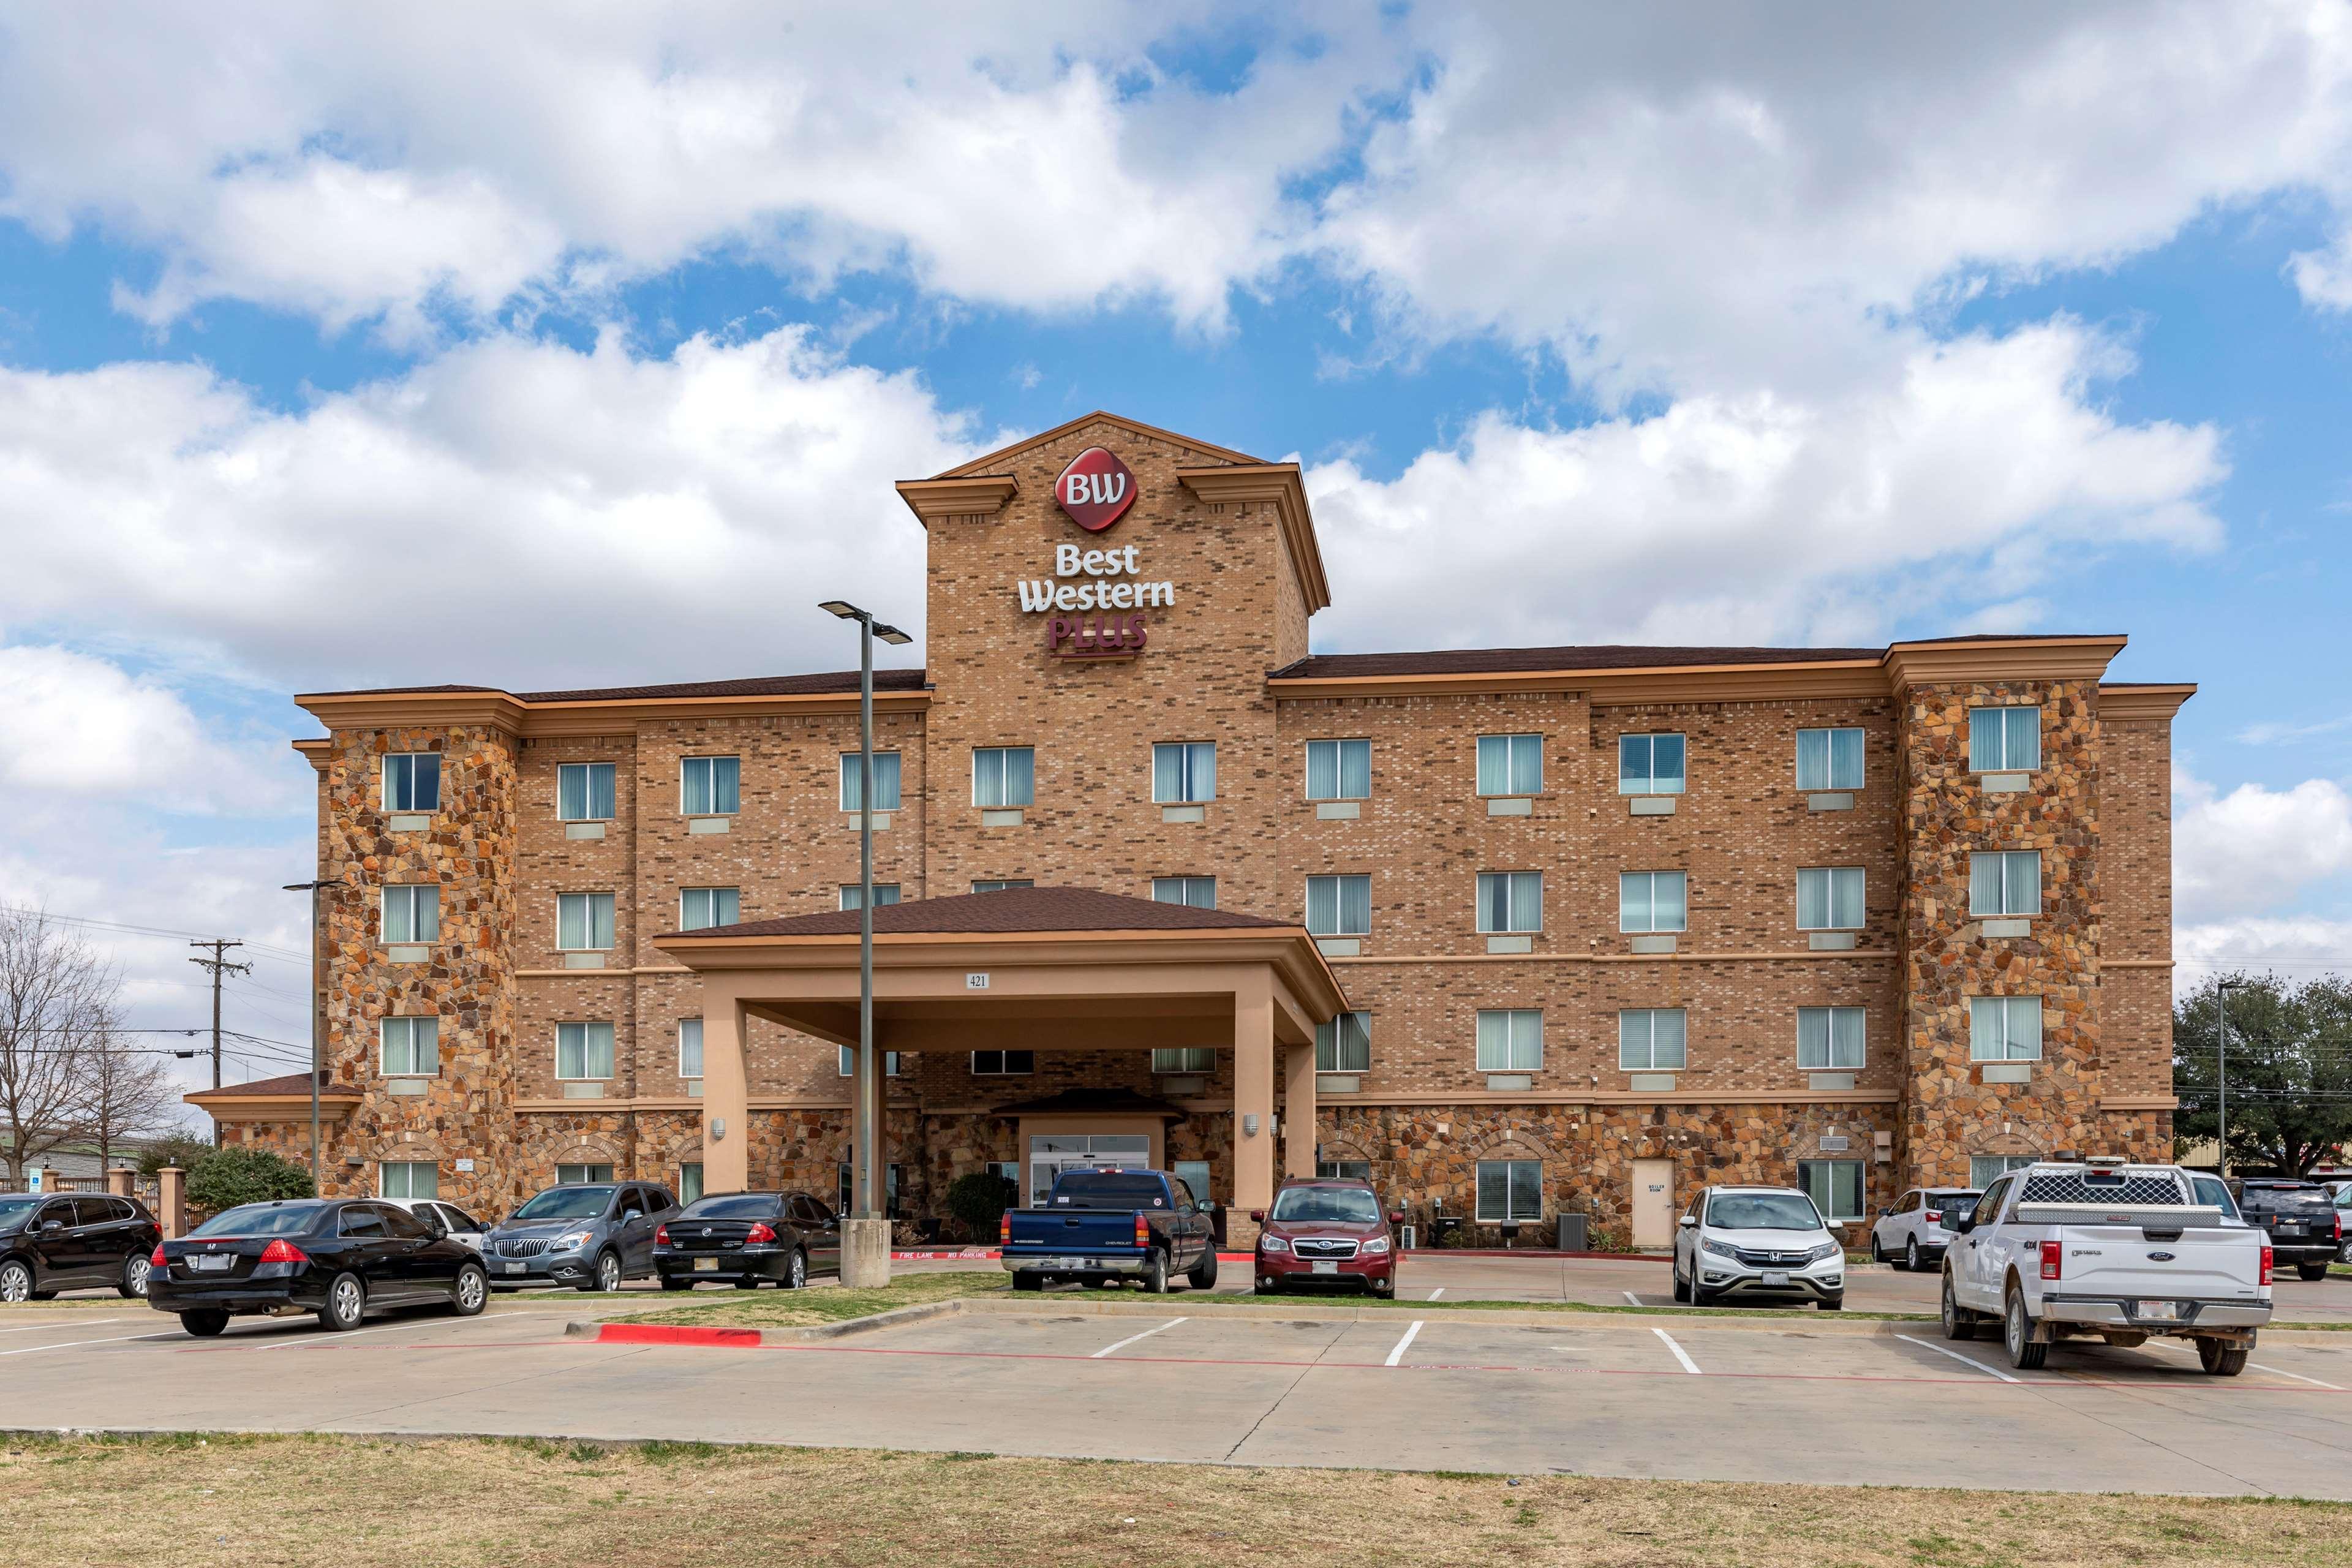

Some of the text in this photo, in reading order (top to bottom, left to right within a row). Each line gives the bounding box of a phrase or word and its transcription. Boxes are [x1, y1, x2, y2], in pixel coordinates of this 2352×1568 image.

[1066, 472, 1126, 505] BW
[1056, 544, 1140, 577] Best
[1017, 579, 1176, 613] Western
[1048, 614, 1148, 650] PLUS
[970, 975, 986, 987] 421
